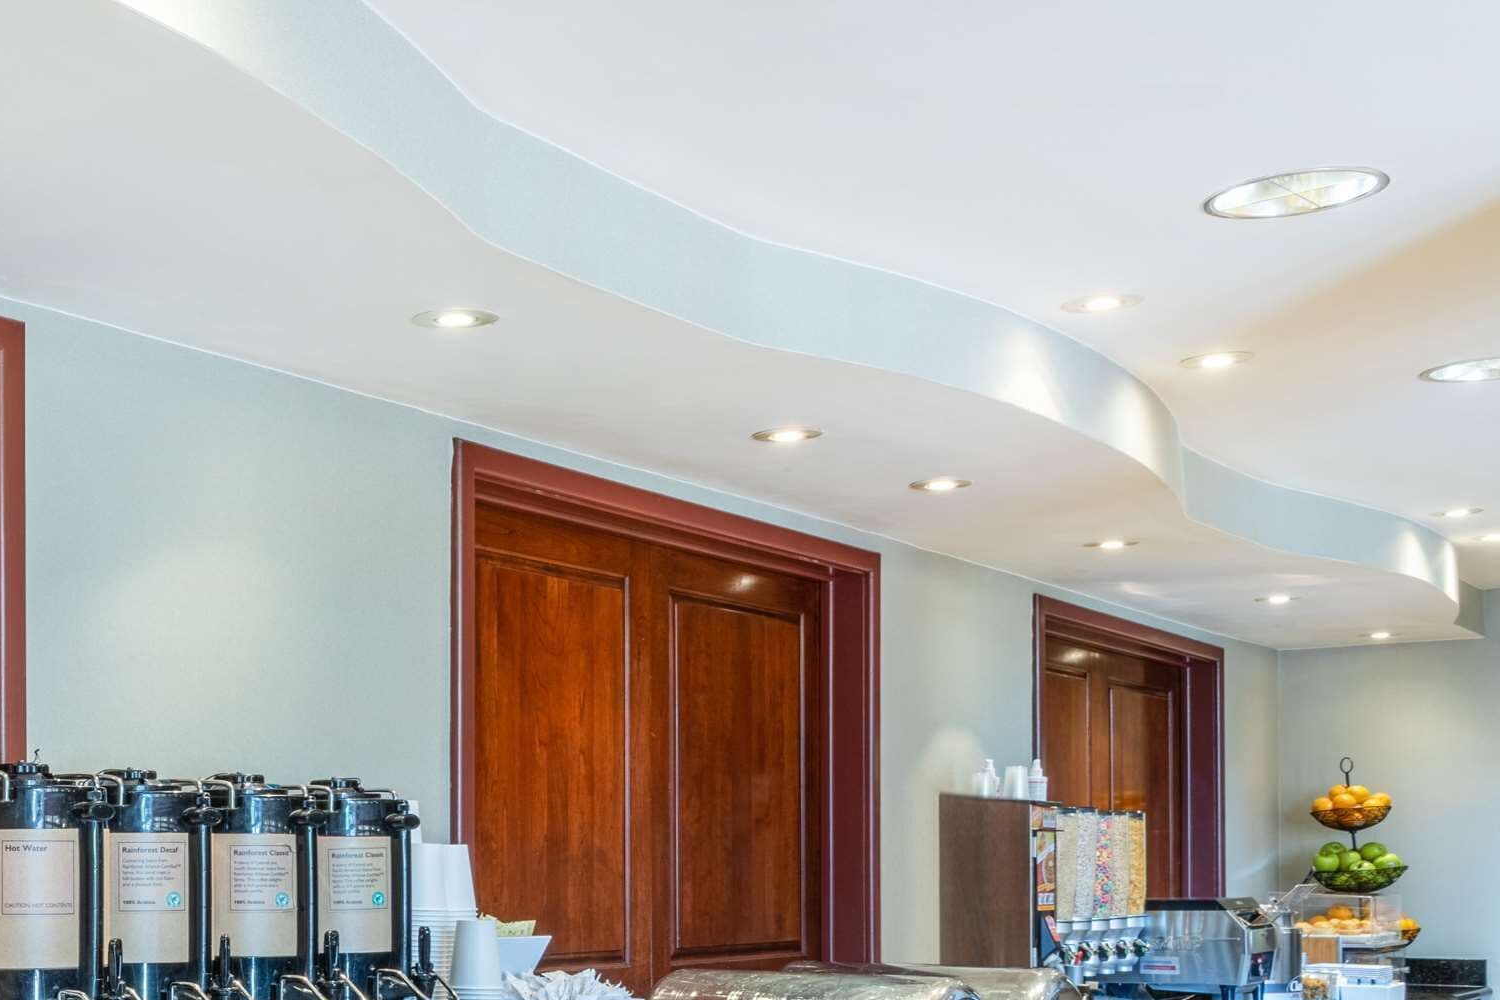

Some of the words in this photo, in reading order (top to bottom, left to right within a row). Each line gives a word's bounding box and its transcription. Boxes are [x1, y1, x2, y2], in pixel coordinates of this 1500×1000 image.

[4, 844, 21, 852] Hot
[22, 844, 48, 852] Water
[122, 846, 158, 854] Rainforest
[160, 846, 179, 854] Decaf
[233, 848, 268, 856] Rainforest
